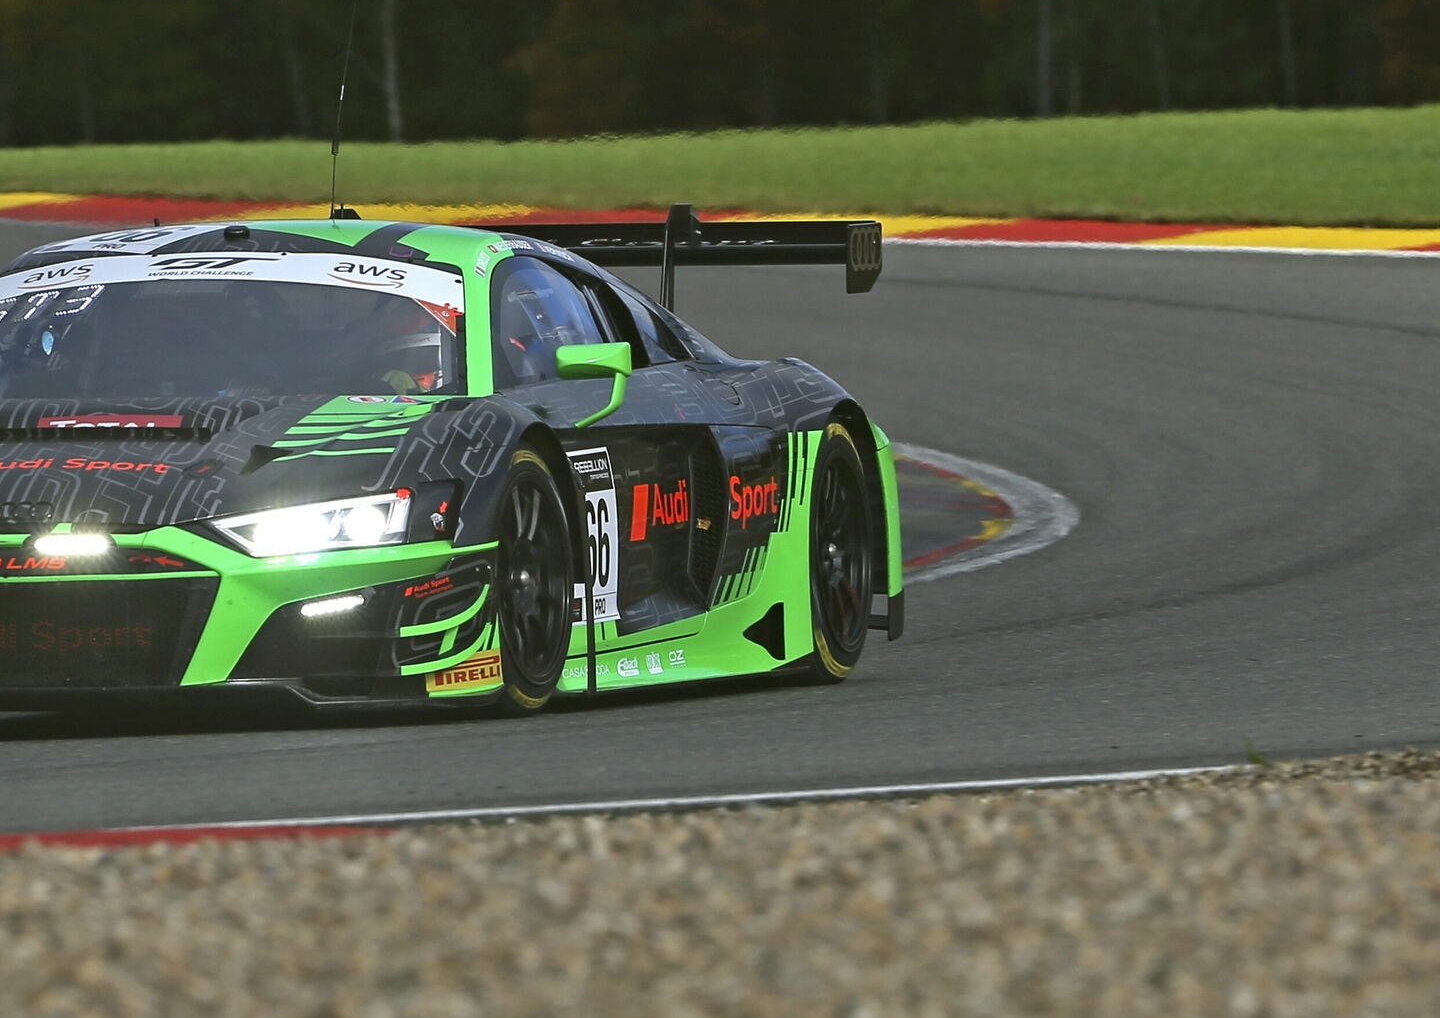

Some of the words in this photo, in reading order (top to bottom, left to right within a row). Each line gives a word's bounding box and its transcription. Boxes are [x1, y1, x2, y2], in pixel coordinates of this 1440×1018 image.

[148, 257, 280, 270] GT
[333, 262, 408, 281] aws
[23, 263, 95, 284] aws
[62, 457, 171, 474] Sport
[652, 479, 689, 527] Audi
[729, 475, 778, 529] Sport
[6, 558, 68, 570] LMS
[595, 597, 607, 615] PRO
[32, 621, 153, 655] Sport
[669, 649, 684, 662] OZ
